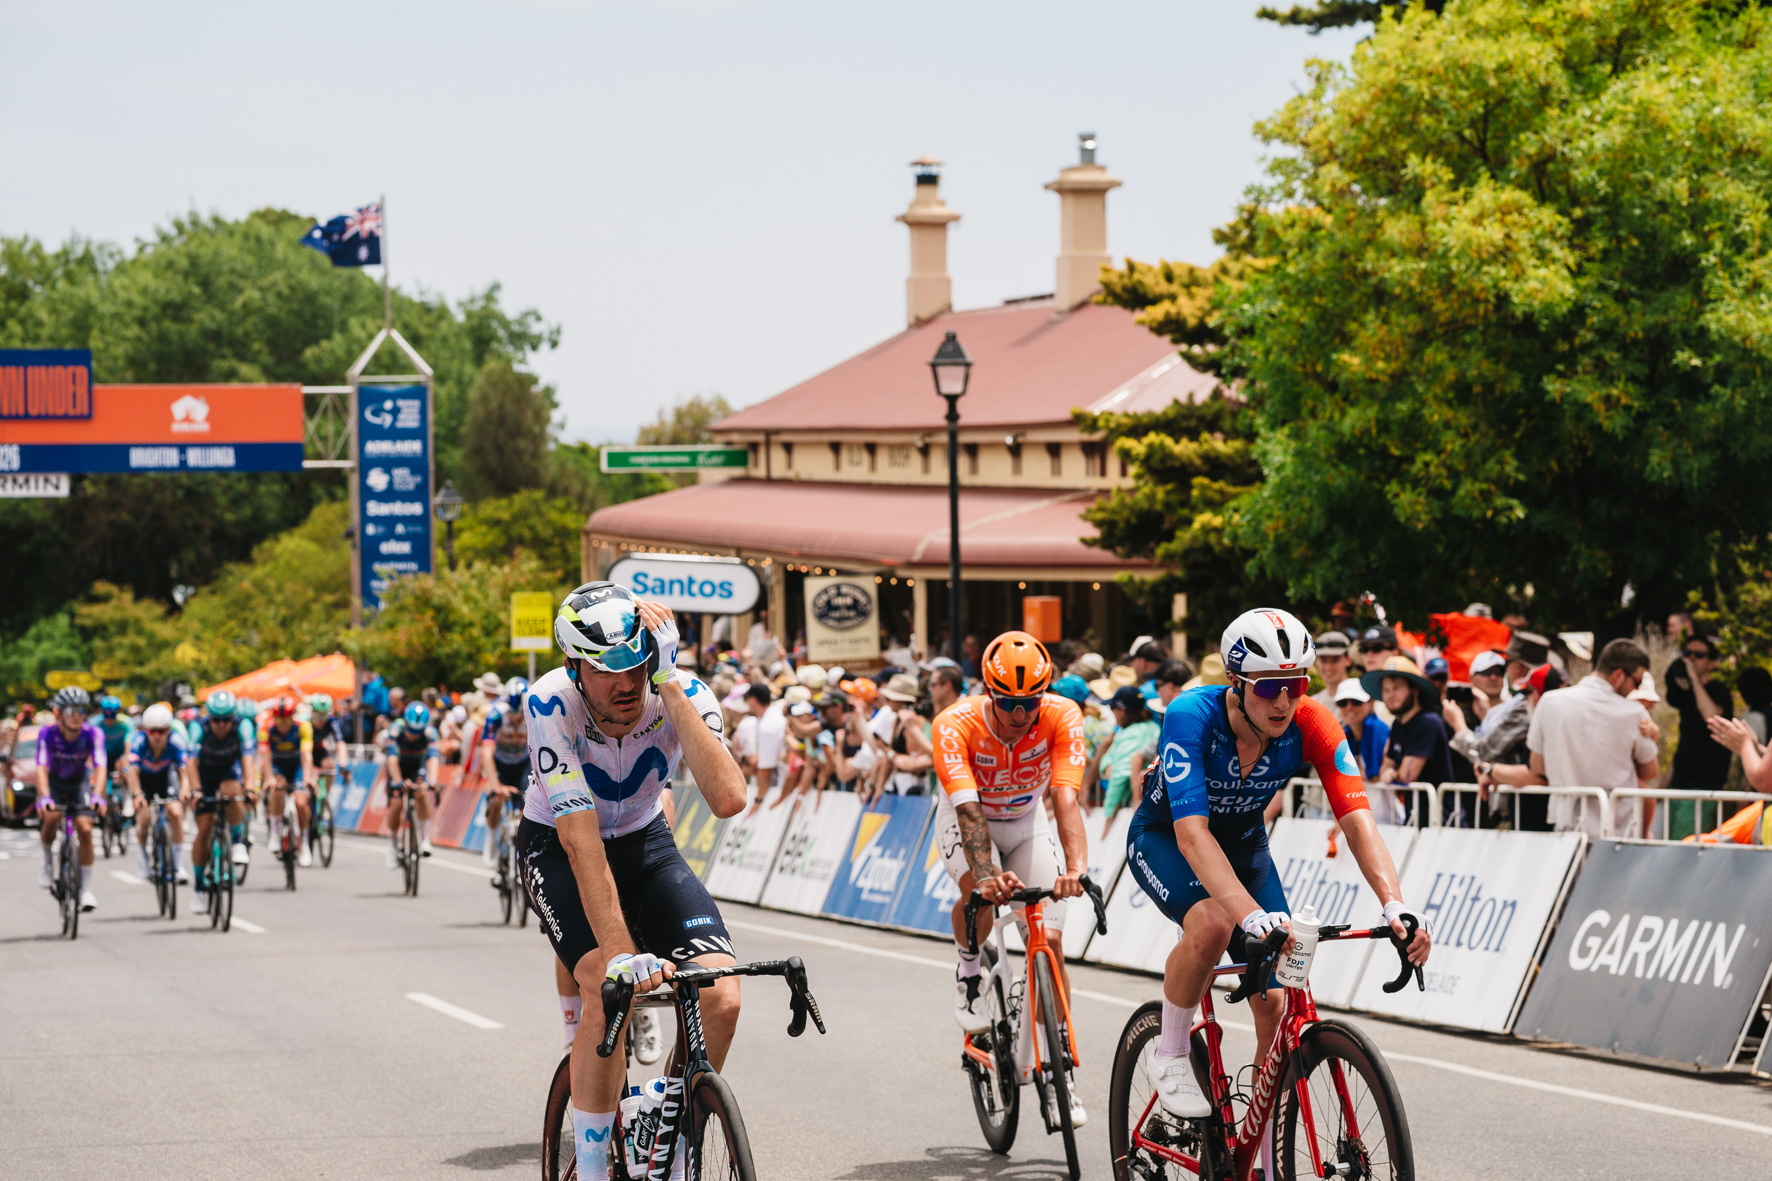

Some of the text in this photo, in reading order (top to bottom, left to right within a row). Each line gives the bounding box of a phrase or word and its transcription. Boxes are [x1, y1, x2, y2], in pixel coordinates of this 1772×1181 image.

[27, 365, 89, 416] UNDER
[129, 447, 180, 468] BRIGHTON
[186, 447, 236, 468] WILLUNGA
[366, 500, 423, 516] Santos
[632, 572, 734, 599] Santos
[939, 724, 969, 780] INEOS
[1063, 707, 1086, 767] INEOS
[1136, 851, 1170, 902] Groupama
[536, 888, 563, 943] Telefónica
[686, 917, 712, 928] GOBIK
[1568, 909, 1746, 989] GARMIN
[684, 999, 698, 1052] CANYON
[1126, 1014, 1160, 1051] MICHE
[1276, 1088, 1290, 1180] MICHE
